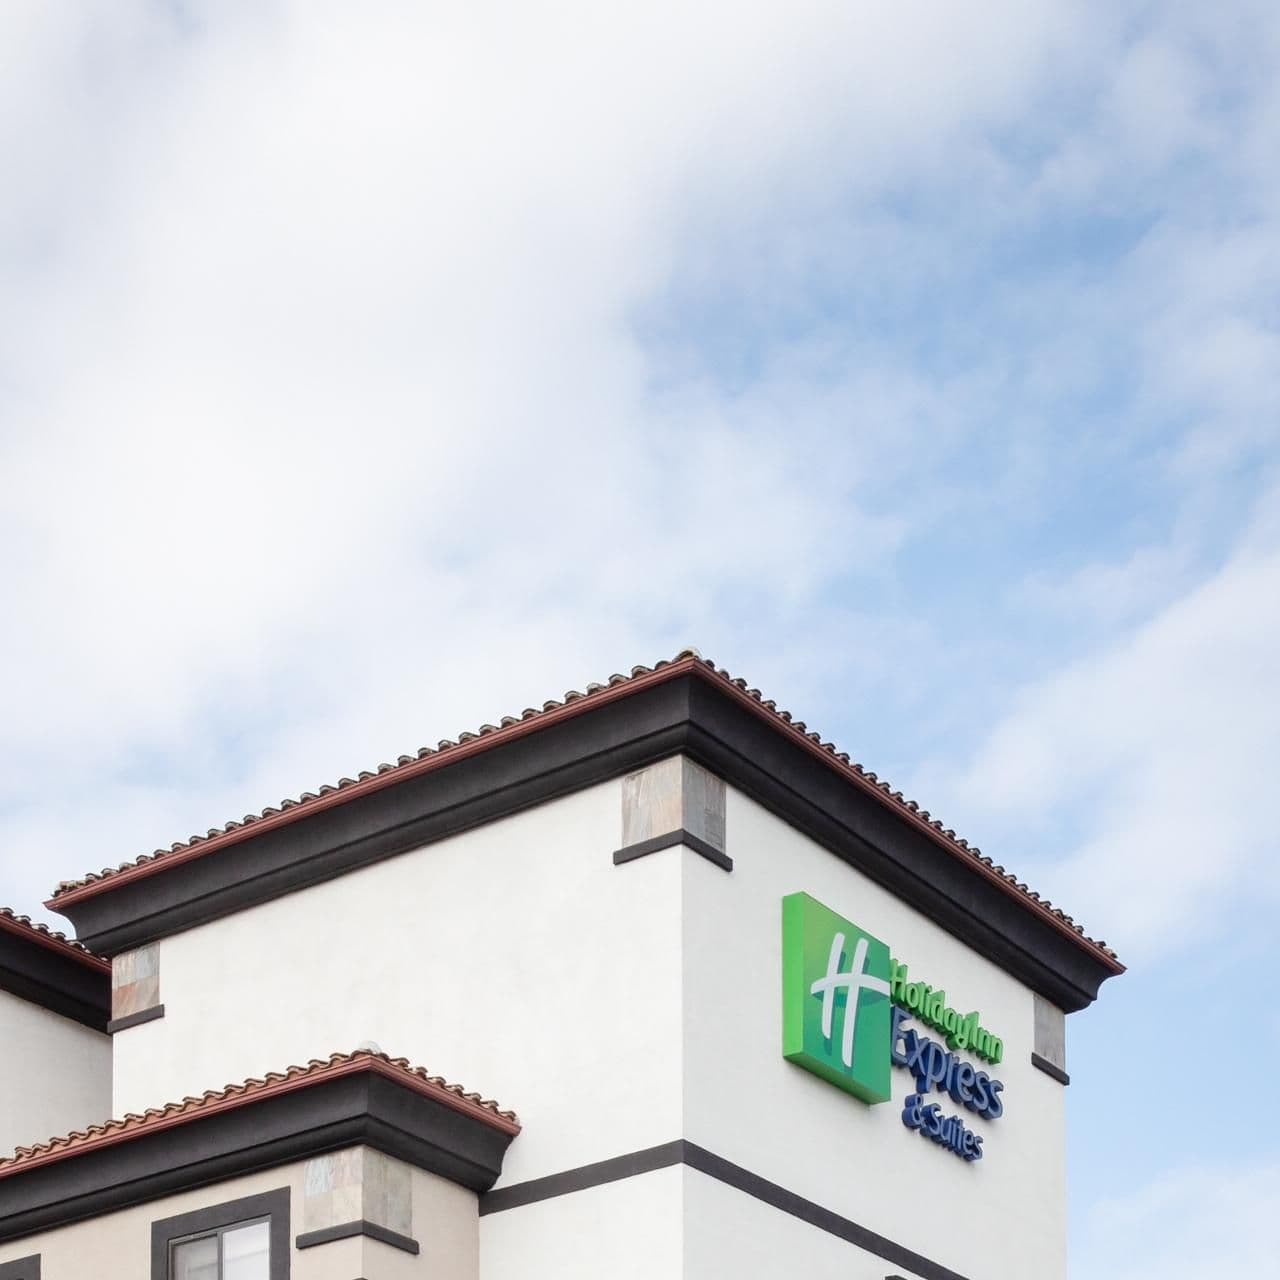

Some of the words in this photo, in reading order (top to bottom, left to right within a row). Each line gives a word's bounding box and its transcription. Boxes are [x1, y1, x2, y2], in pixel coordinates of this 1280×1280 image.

[890, 958, 972, 1051] Holiday
[967, 1011, 1004, 1065] Inn
[890, 1003, 1004, 1121] Express
[901, 1093, 925, 1130] &
[922, 1102, 984, 1162] Suites
